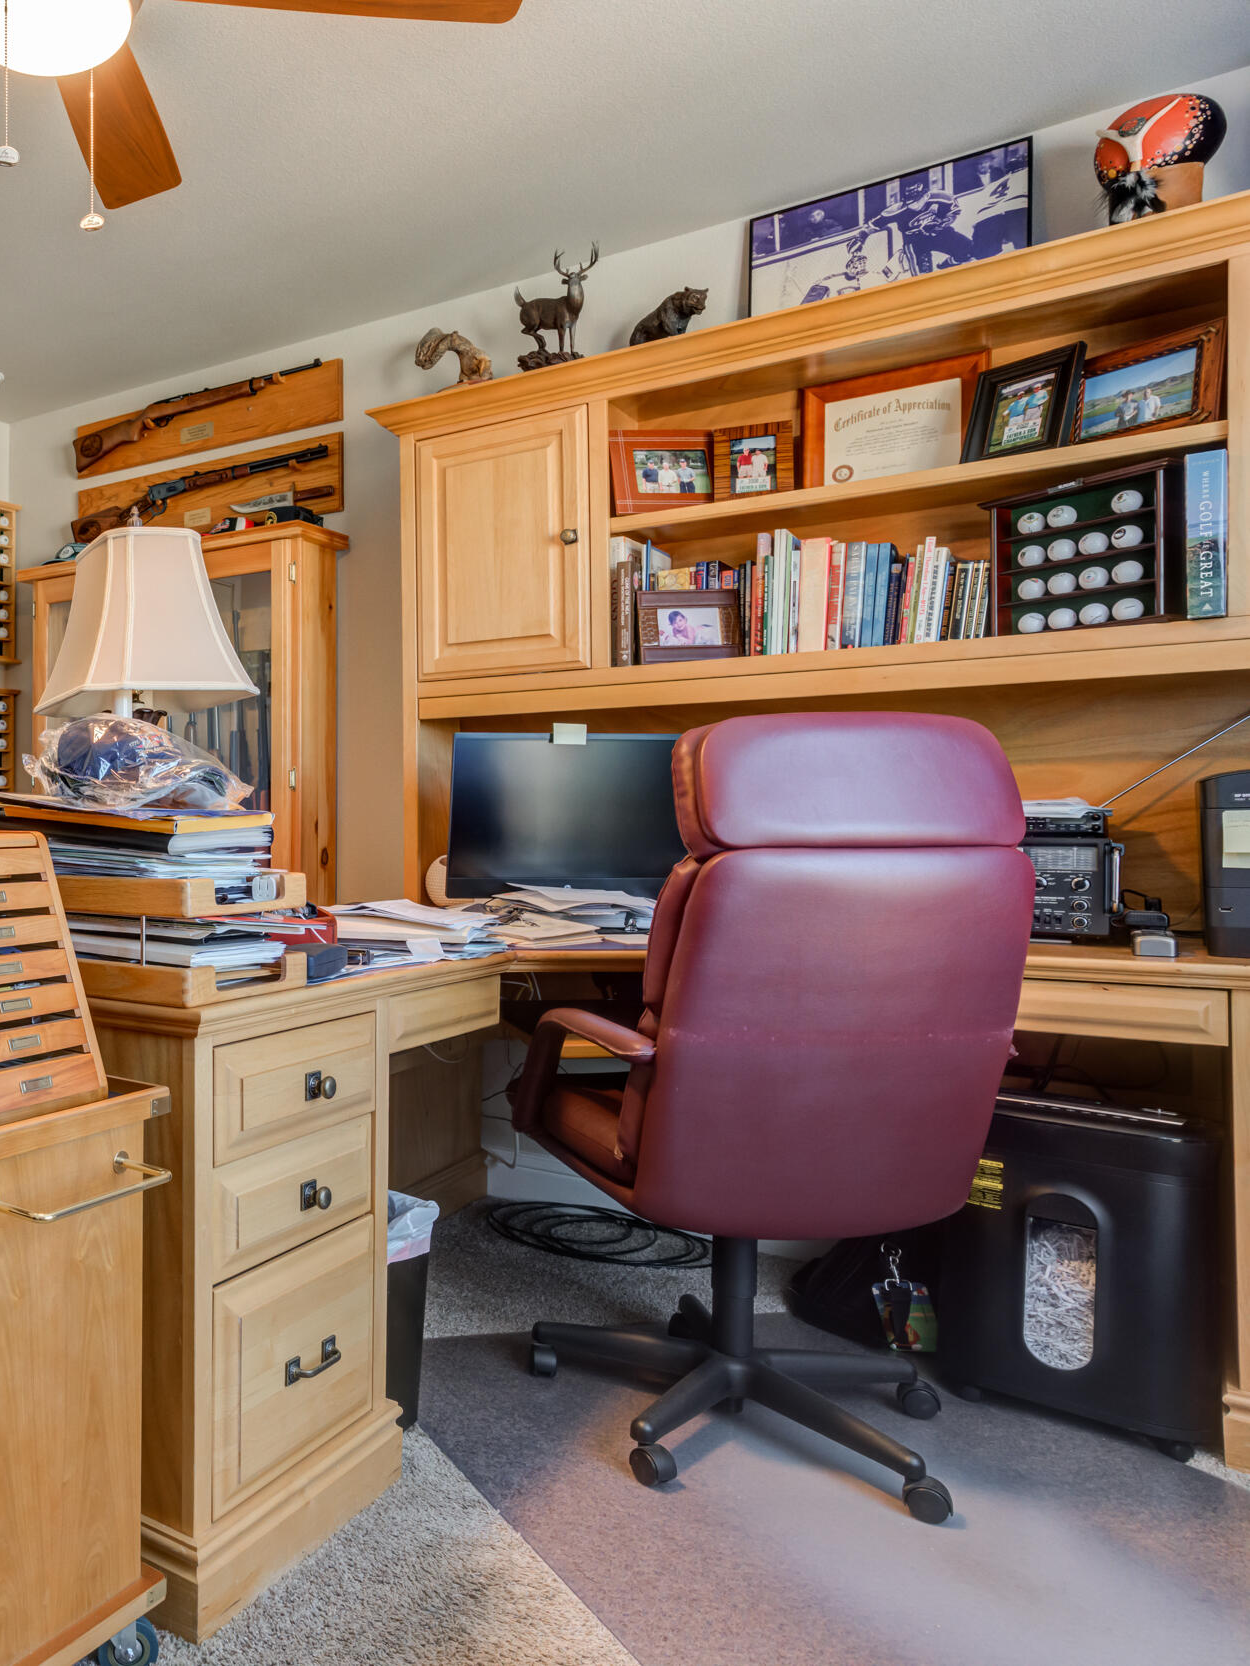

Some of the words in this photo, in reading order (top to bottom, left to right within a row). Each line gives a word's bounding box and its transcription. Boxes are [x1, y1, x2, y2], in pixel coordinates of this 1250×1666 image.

[834, 406, 880, 432] Certificate
[882, 401, 892, 414] of
[894, 398, 951, 414] Appreciation
[1202, 470, 1210, 498] WHERE
[1200, 500, 1212, 536] GOLF
[1200, 550, 1213, 597] GREAT
[928, 581, 937, 611] HOLLOW
